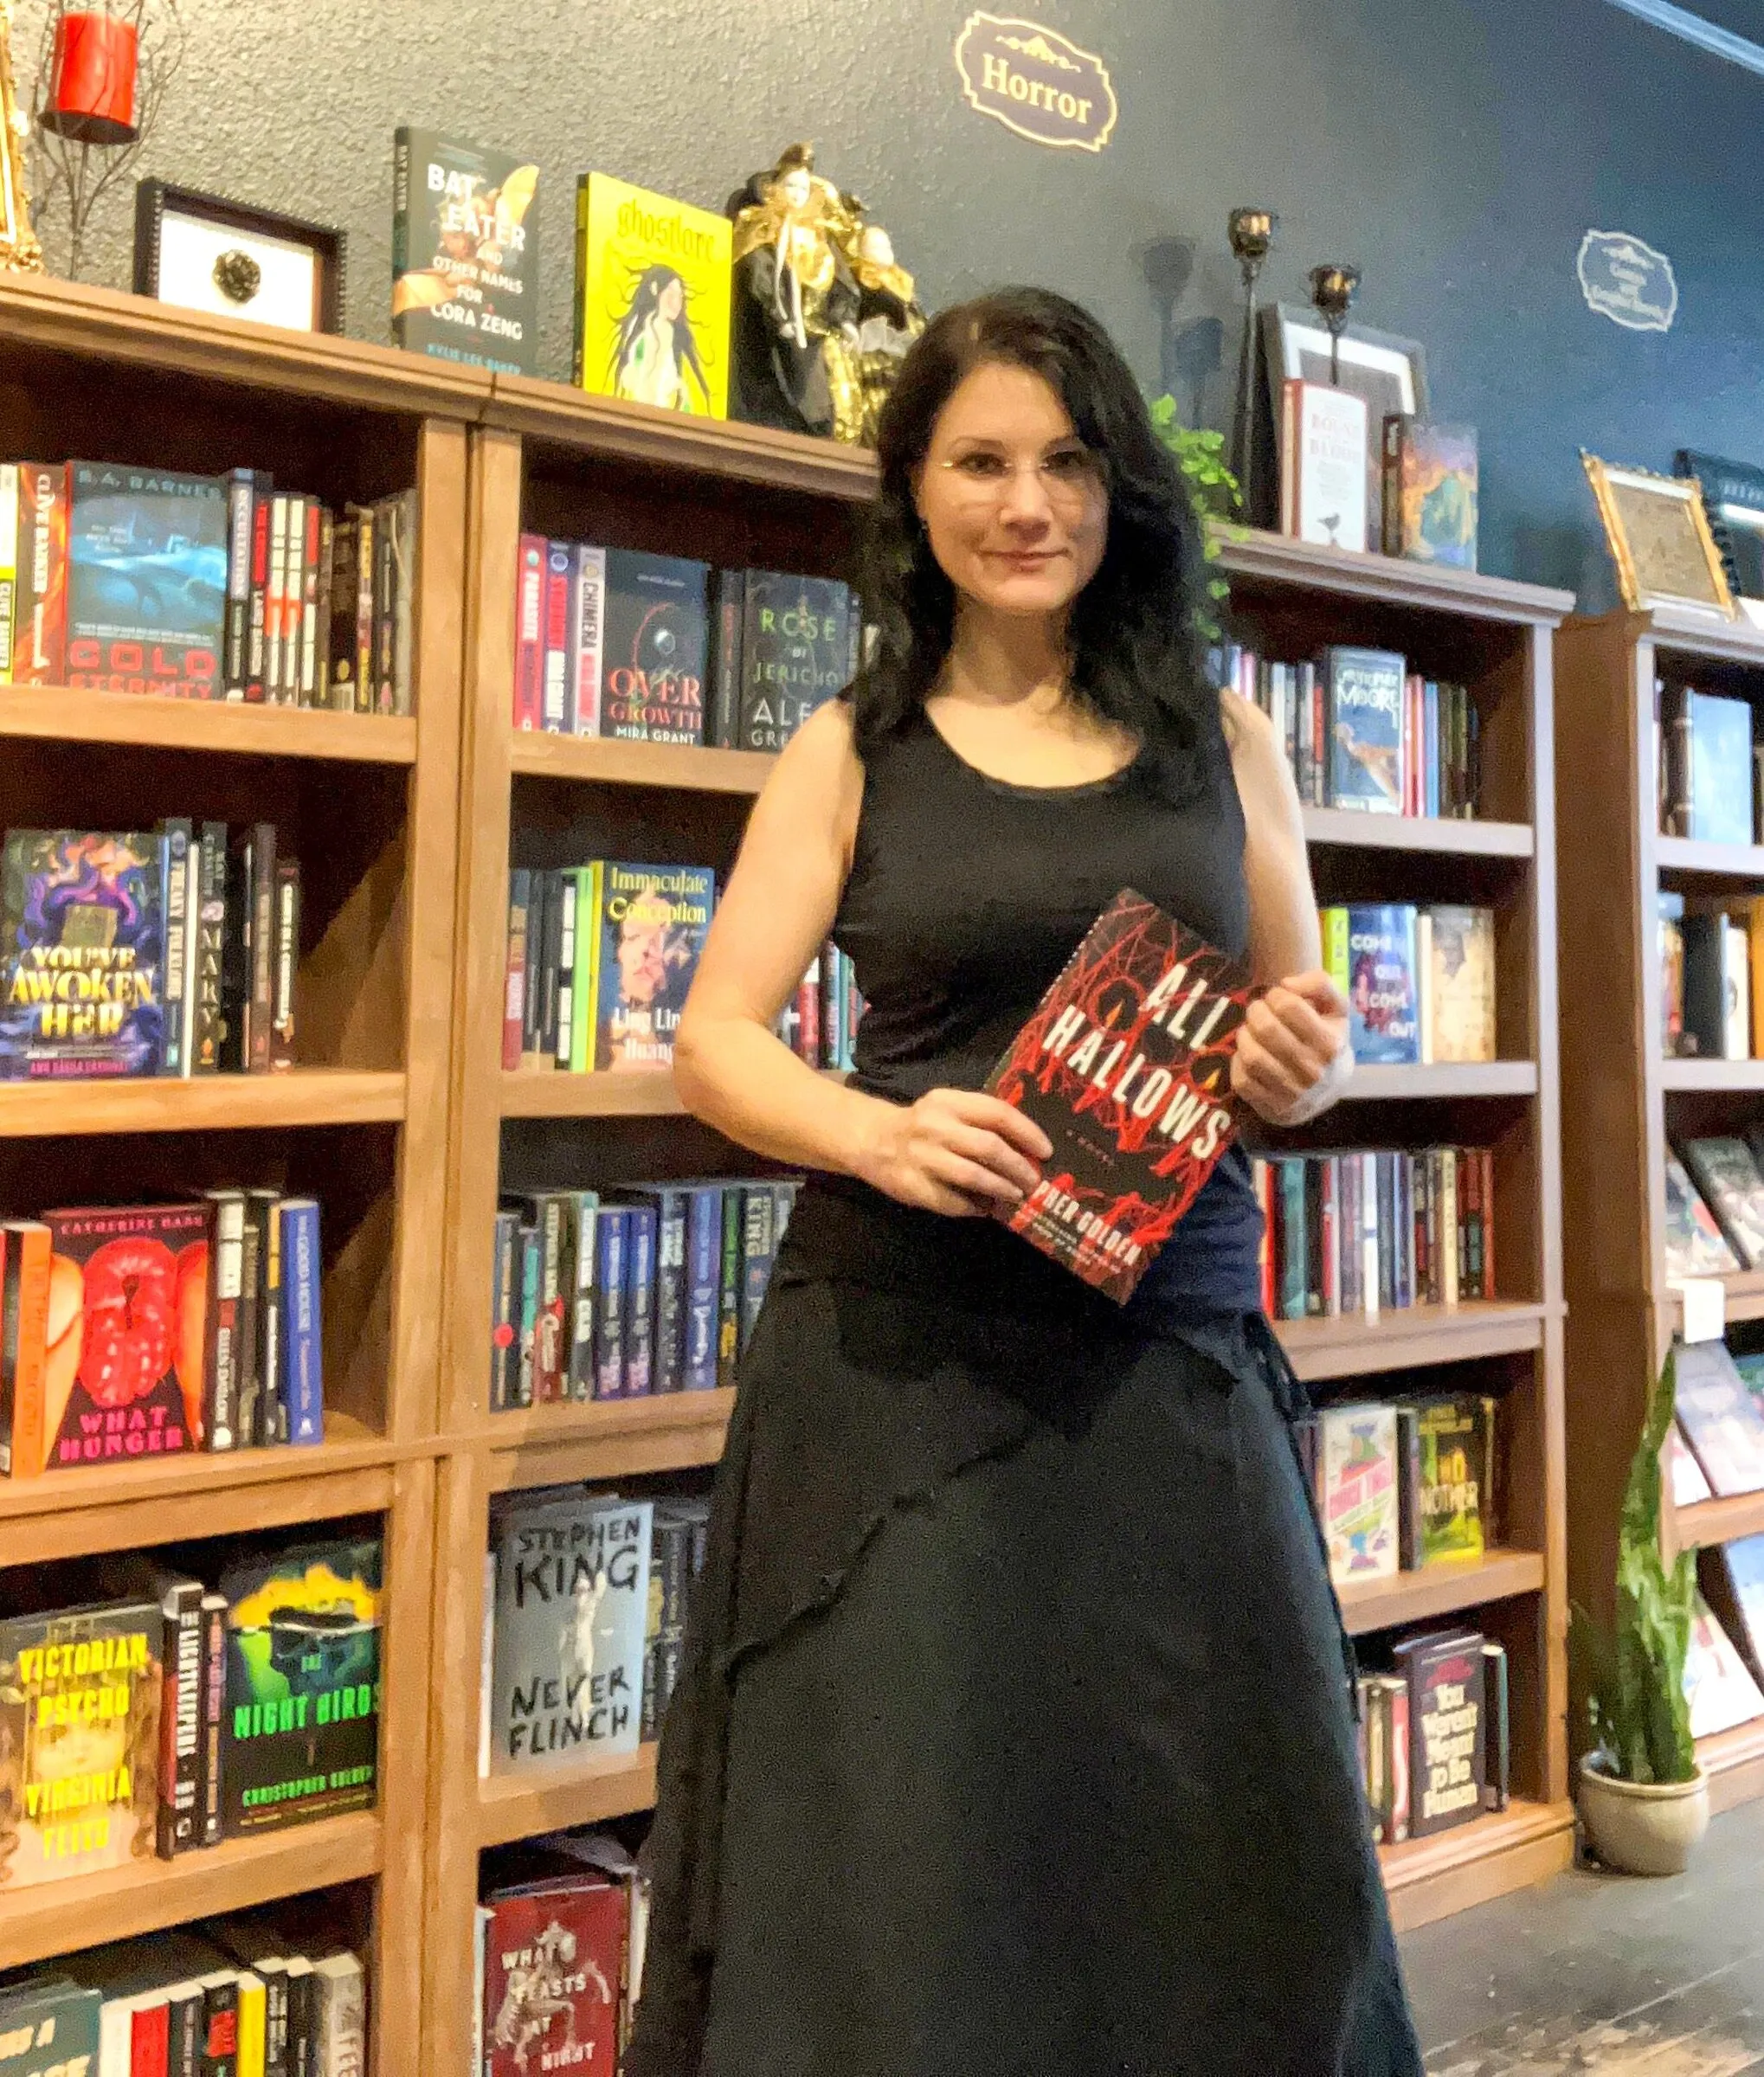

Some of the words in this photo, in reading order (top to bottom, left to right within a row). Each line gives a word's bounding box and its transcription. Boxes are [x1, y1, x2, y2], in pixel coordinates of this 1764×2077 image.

[982, 52, 1092, 124] Horror
[428, 164, 475, 204] BAT
[443, 203, 526, 251] EATER
[616, 199, 715, 264] ghostlore
[433, 255, 479, 280] OTHER
[480, 272, 524, 294] NAMES
[456, 284, 483, 305] FOR
[430, 302, 476, 327] CORA
[480, 313, 523, 341] ZENG
[35, 473, 56, 524] CLIVE
[582, 582, 599, 649] CHIMERA
[759, 608, 837, 642] ROSE
[69, 638, 216, 679] COLD
[69, 674, 213, 700] ETERNITY
[608, 668, 702, 707] OVER
[608, 702, 702, 730] GROWTH
[615, 724, 647, 741] MIRA
[653, 730, 696, 746] GRANT
[611, 866, 709, 894] Immaculate
[609, 896, 707, 924] Conception
[30, 946, 137, 968] YOU'VE
[10, 965, 157, 1010] AWOKEN
[40, 1001, 124, 1038] HER
[654, 1007, 681, 1031] Lin
[1042, 1004, 1232, 1161] HALLOWS
[60, 1217, 156, 1236] CATHERINE
[745, 1196, 763, 1257] KING
[1076, 1211, 1143, 1266] GOLDEN
[80, 1405, 169, 1434] WHAT
[59, 1425, 184, 1462] HUNGER
[519, 1515, 641, 1553] STEPHEN
[514, 1544, 639, 1610] KING
[18, 1632, 149, 1684] VICTORIAN
[37, 1684, 130, 1729] PSYCHO
[234, 1692, 309, 1739] NIGHT
[316, 1684, 371, 1725] BIRD
[511, 1665, 630, 1720] NEVER
[508, 1703, 630, 1760] FLINCH
[27, 1765, 132, 1817] VIRGINIA
